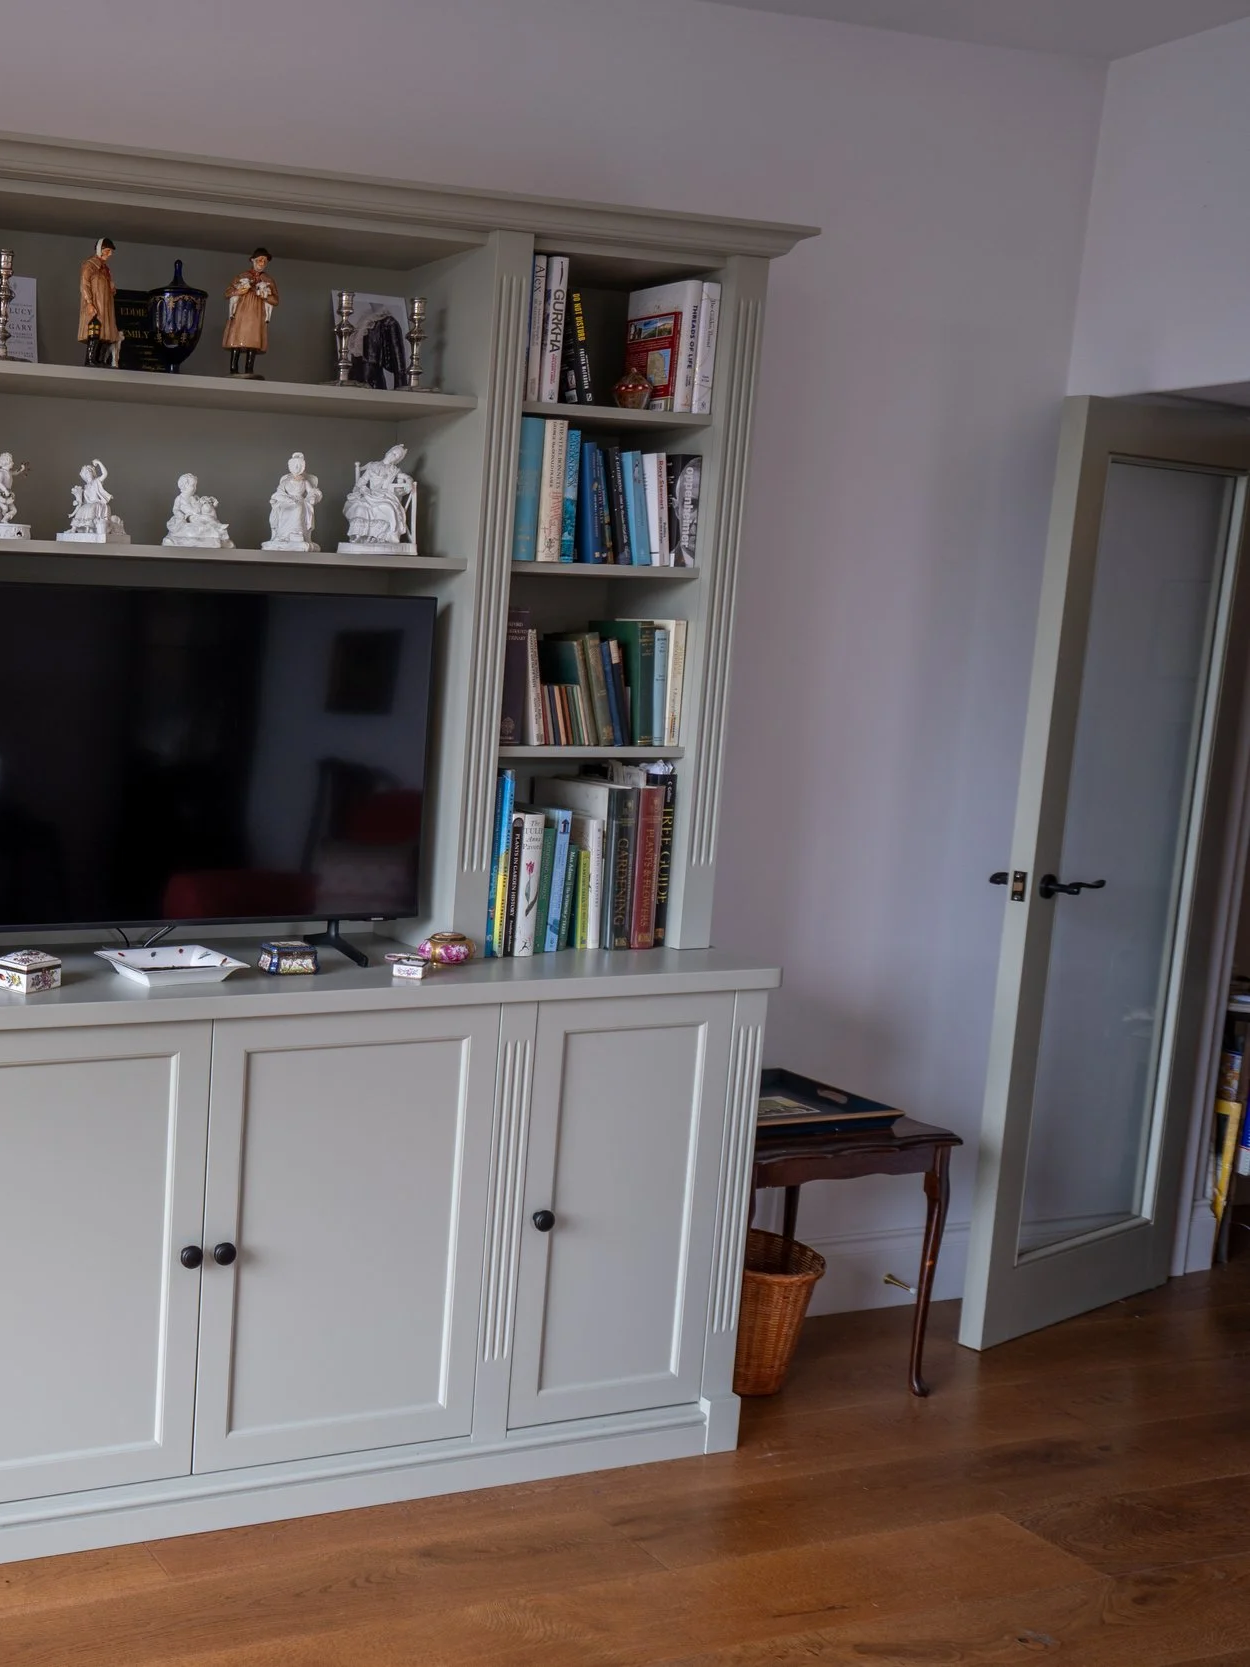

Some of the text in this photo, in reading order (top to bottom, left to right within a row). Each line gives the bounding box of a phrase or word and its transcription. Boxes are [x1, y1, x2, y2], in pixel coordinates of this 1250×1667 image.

[534, 264, 545, 294] Alex
[120, 307, 147, 316] EDDIE
[549, 289, 565, 353] GURKHA
[573, 293, 586, 341] DO NOT DISTURB
[690, 305, 698, 338] THREADS
[689, 341, 695, 351] OF
[681, 467, 694, 548] oppenheimer
[513, 833, 521, 856] PLANTS
[657, 806, 674, 904] TREE GUIDE
[511, 866, 519, 891] GARDEN
[614, 838, 629, 926] GARDENING
[640, 828, 654, 927] PLANTS & FLOWERS
[509, 892, 518, 916] HISTORY
